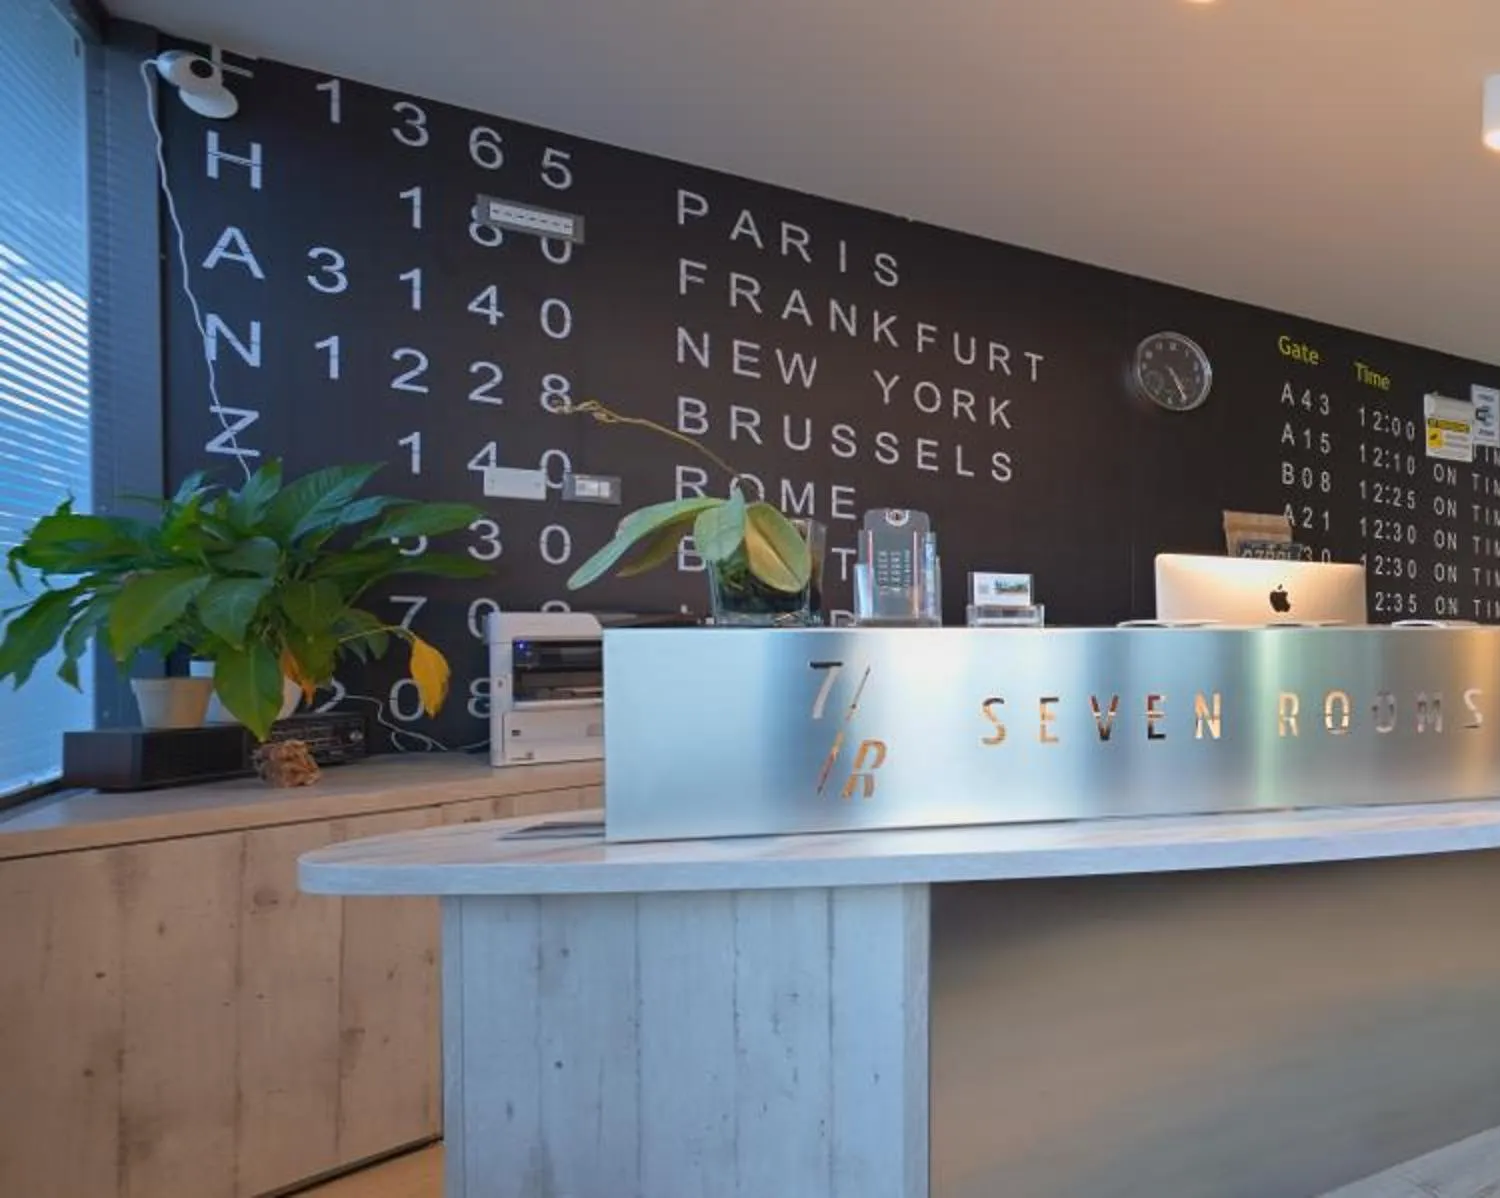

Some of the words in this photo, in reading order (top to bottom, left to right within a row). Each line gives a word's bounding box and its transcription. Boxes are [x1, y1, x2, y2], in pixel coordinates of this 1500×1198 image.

[315, 79, 573, 190] 1365
[677, 189, 899, 287] PARIS
[306, 247, 573, 339] 3140
[677, 327, 817, 389] NEW
[874, 370, 1013, 430] YORK
[678, 259, 1044, 382] FRANKFURT
[1278, 335, 1319, 366] Gate
[1354, 361, 1390, 391] Time
[314, 335, 573, 414] 1228
[677, 396, 1013, 482] BRUSSELS
[1280, 383, 1330, 416] A43
[1358, 407, 1415, 442] 12:00
[1281, 423, 1330, 454] A15
[1359, 444, 1415, 476] 12:10
[1434, 463, 1457, 487] ON
[675, 465, 856, 520] ROME
[1281, 462, 1331, 492] B08
[1359, 480, 1416, 510] 12:25
[1433, 497, 1457, 519] ON
[1283, 503, 1330, 531] A21
[1360, 517, 1417, 545] 12:30
[1434, 529, 1457, 551] ON
[1434, 562, 1457, 583] ON
[1435, 595, 1458, 616] ON
[980, 691, 1221, 745] SEVEN
[1278, 688, 1484, 737] ROOMS
